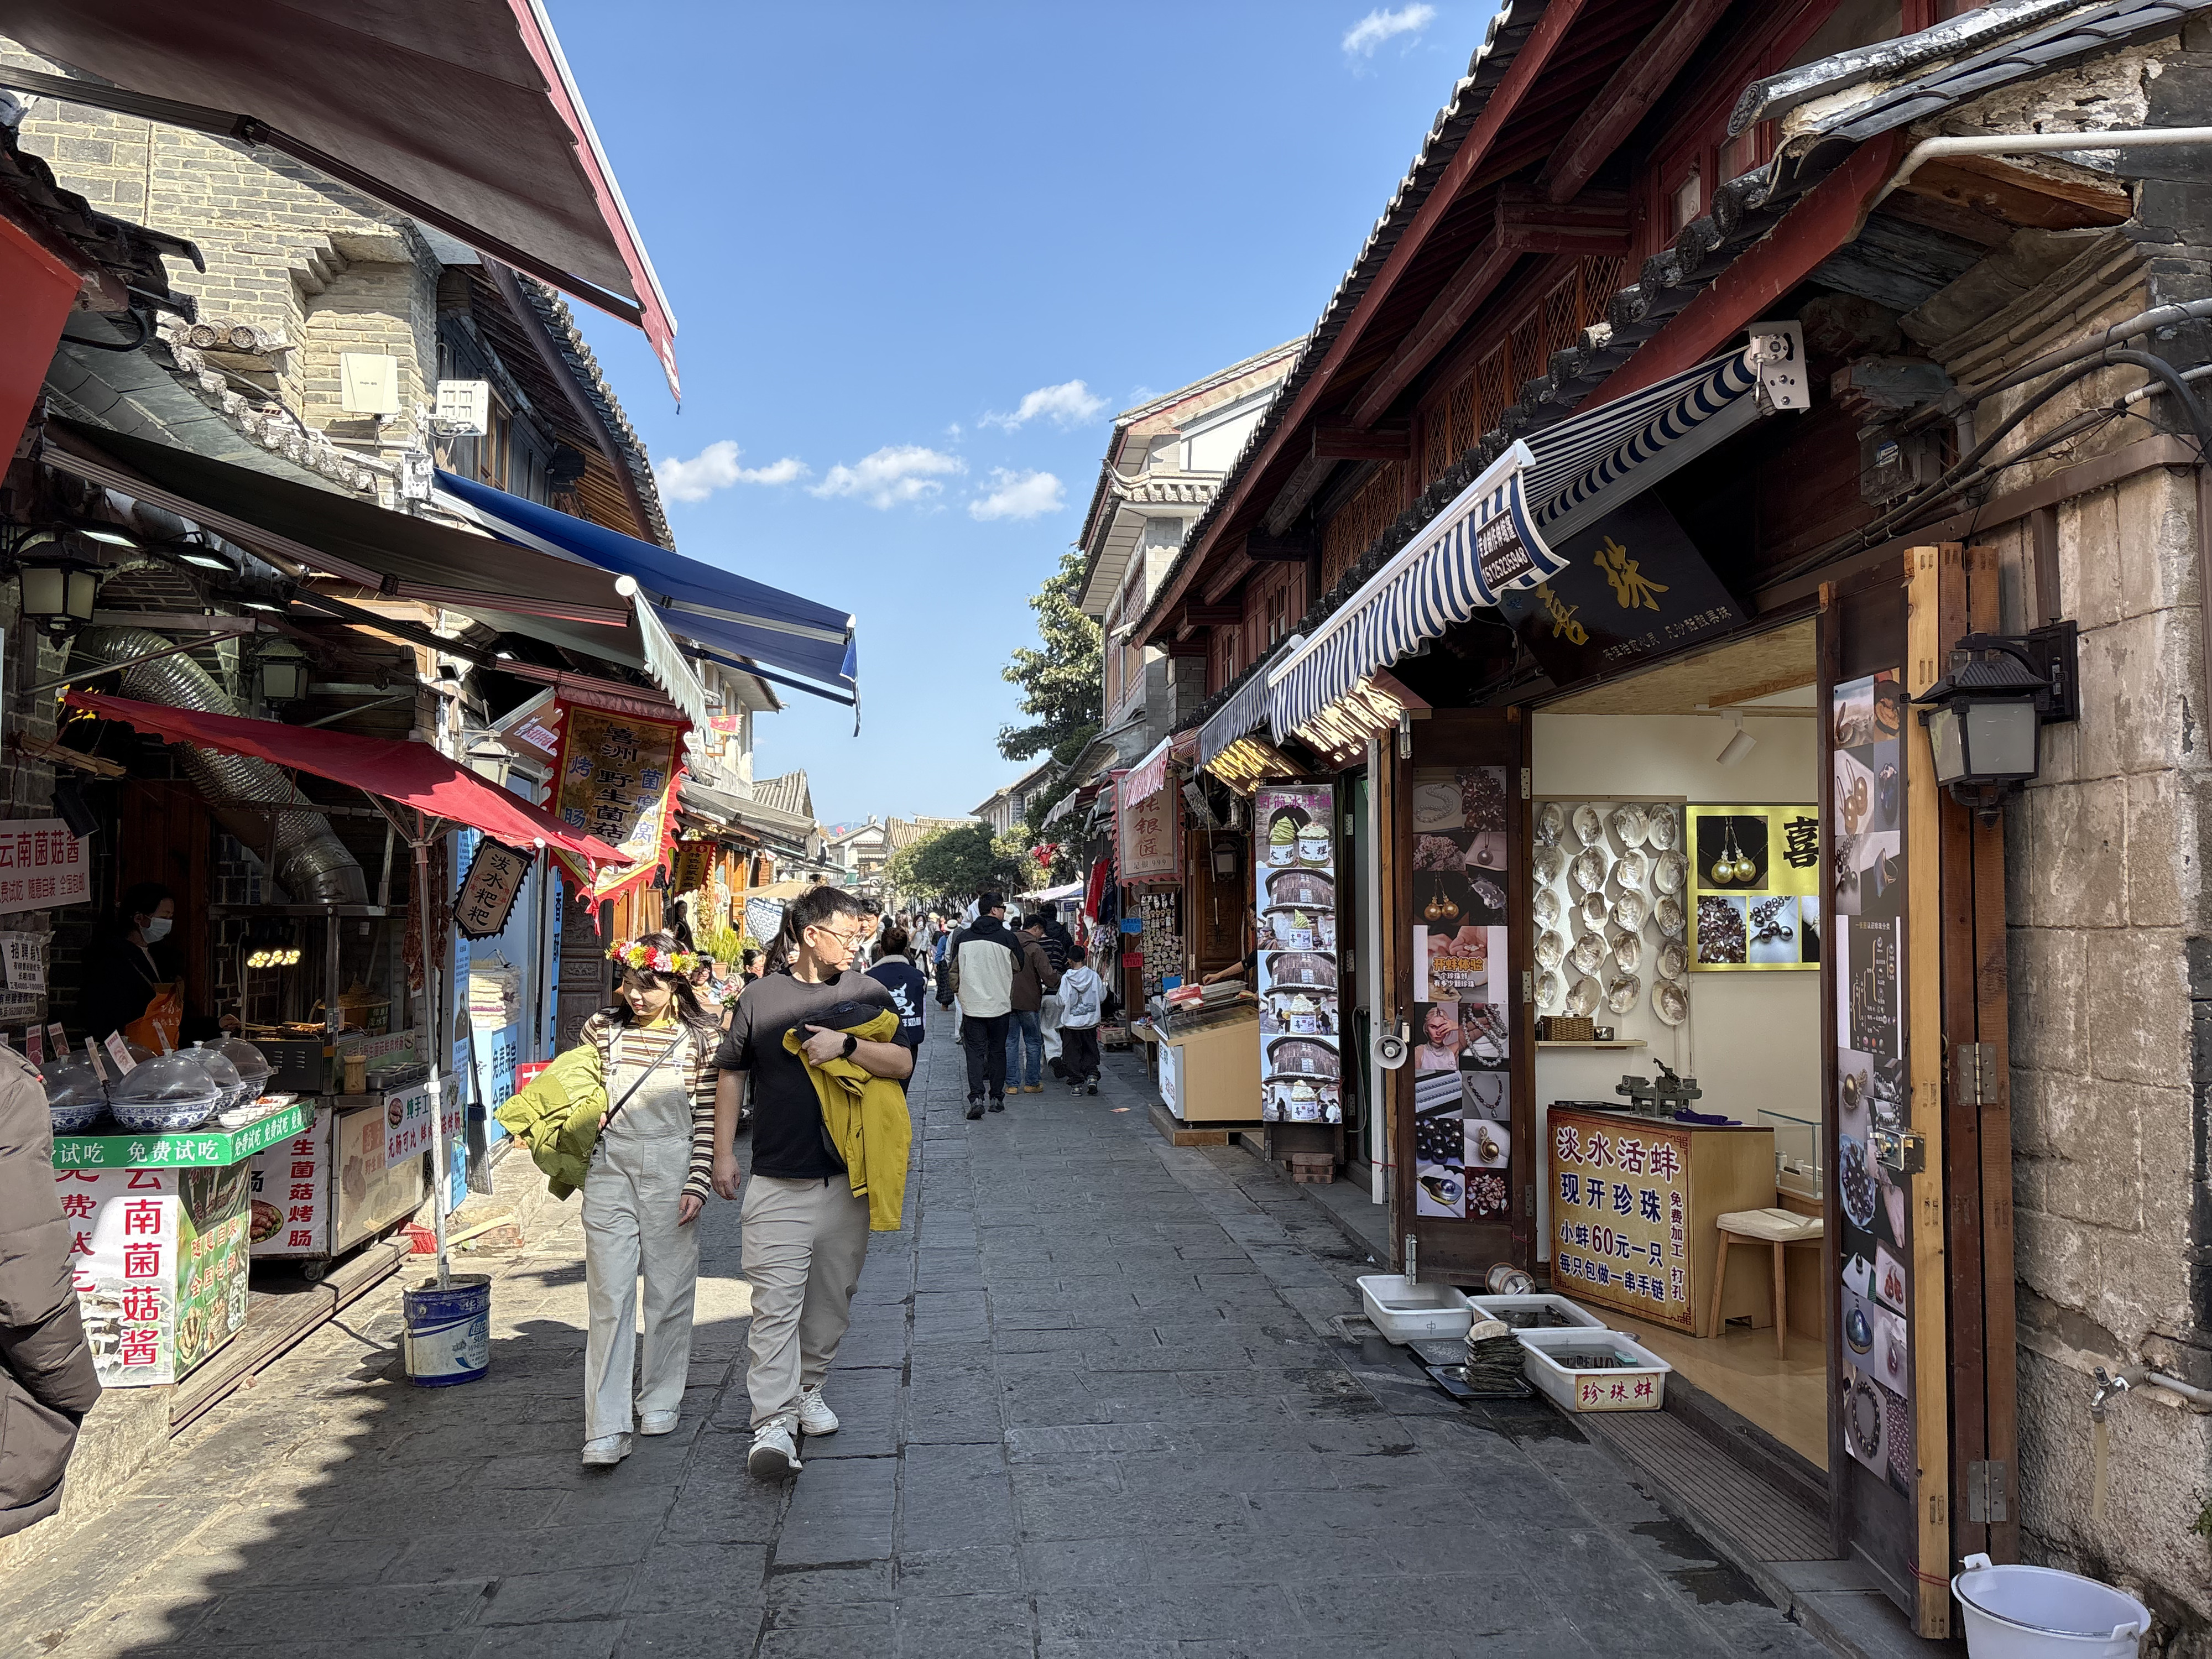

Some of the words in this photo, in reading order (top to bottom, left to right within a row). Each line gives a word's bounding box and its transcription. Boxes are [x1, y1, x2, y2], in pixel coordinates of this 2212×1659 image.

[1482, 546, 1528, 585] 15125235948
[564, 755, 594, 830] 烤肠
[588, 722, 640, 848] 喜洲·野生菌菇
[1259, 795, 1331, 809] 竹筒冰淇淋
[0, 830, 80, 868] 云南菌菇酱
[1271, 848, 1293, 860] 大理
[1300, 844, 1328, 855] 大理
[1783, 816, 1819, 869] 喜
[28, 875, 56, 900] 随意自装
[60, 872, 85, 895] 全国包邮
[467, 854, 511, 926] 泼水粑粑
[1433, 957, 1484, 971] 开蚌体验
[51, 1142, 105, 1164] 试吃
[127, 1139, 220, 1164] 免费试吃
[234, 1126, 262, 1157] 免费试吃
[264, 1115, 289, 1143] 免费试吃
[1556, 1126, 1682, 1183] 淡水活蚌
[288, 1118, 317, 1247] 生菌菇烤肠
[365, 1152, 385, 1175] 野生菌
[1559, 1172, 1662, 1224] 现开珍珠
[191, 1217, 238, 1262] 随意自装
[1559, 1220, 1663, 1269] 小蚌60元一只
[1670, 1191, 1684, 1258] 免费加工
[121, 1169, 164, 1365] 云南菌菇酱
[191, 1251, 237, 1299] 全国包邮
[1558, 1252, 1665, 1302] 每只包做一串手链
[1671, 1266, 1685, 1302] 打孔
[1582, 1380, 1654, 1406] 珍珠蚌
